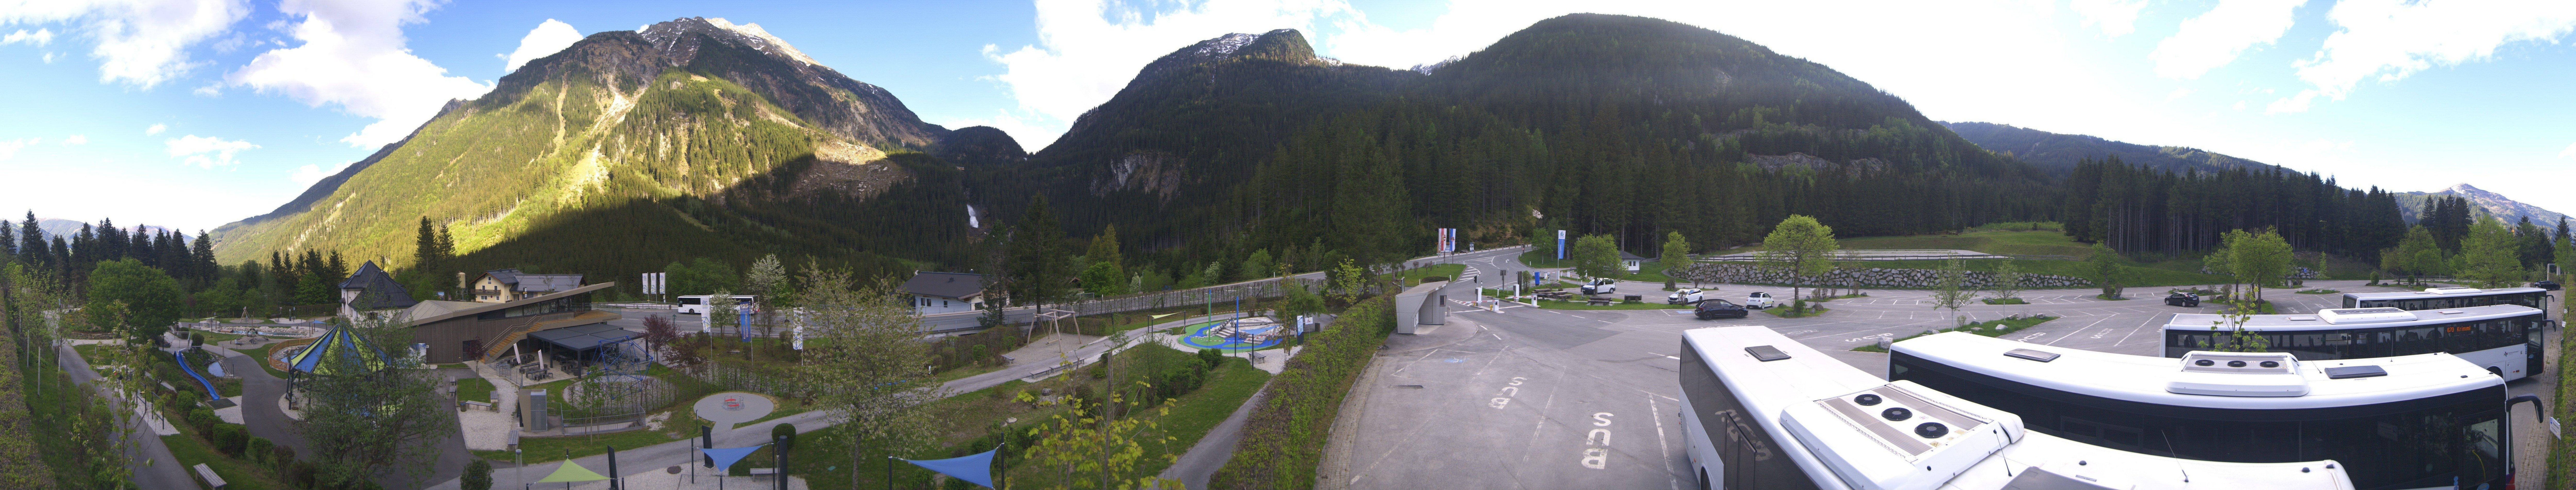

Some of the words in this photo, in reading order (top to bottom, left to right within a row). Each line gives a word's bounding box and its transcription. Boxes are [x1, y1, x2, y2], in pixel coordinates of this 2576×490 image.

[1845, 333, 1893, 342] BUS
[1488, 377, 1527, 409] BUS
[1581, 412, 1614, 469] BUS
